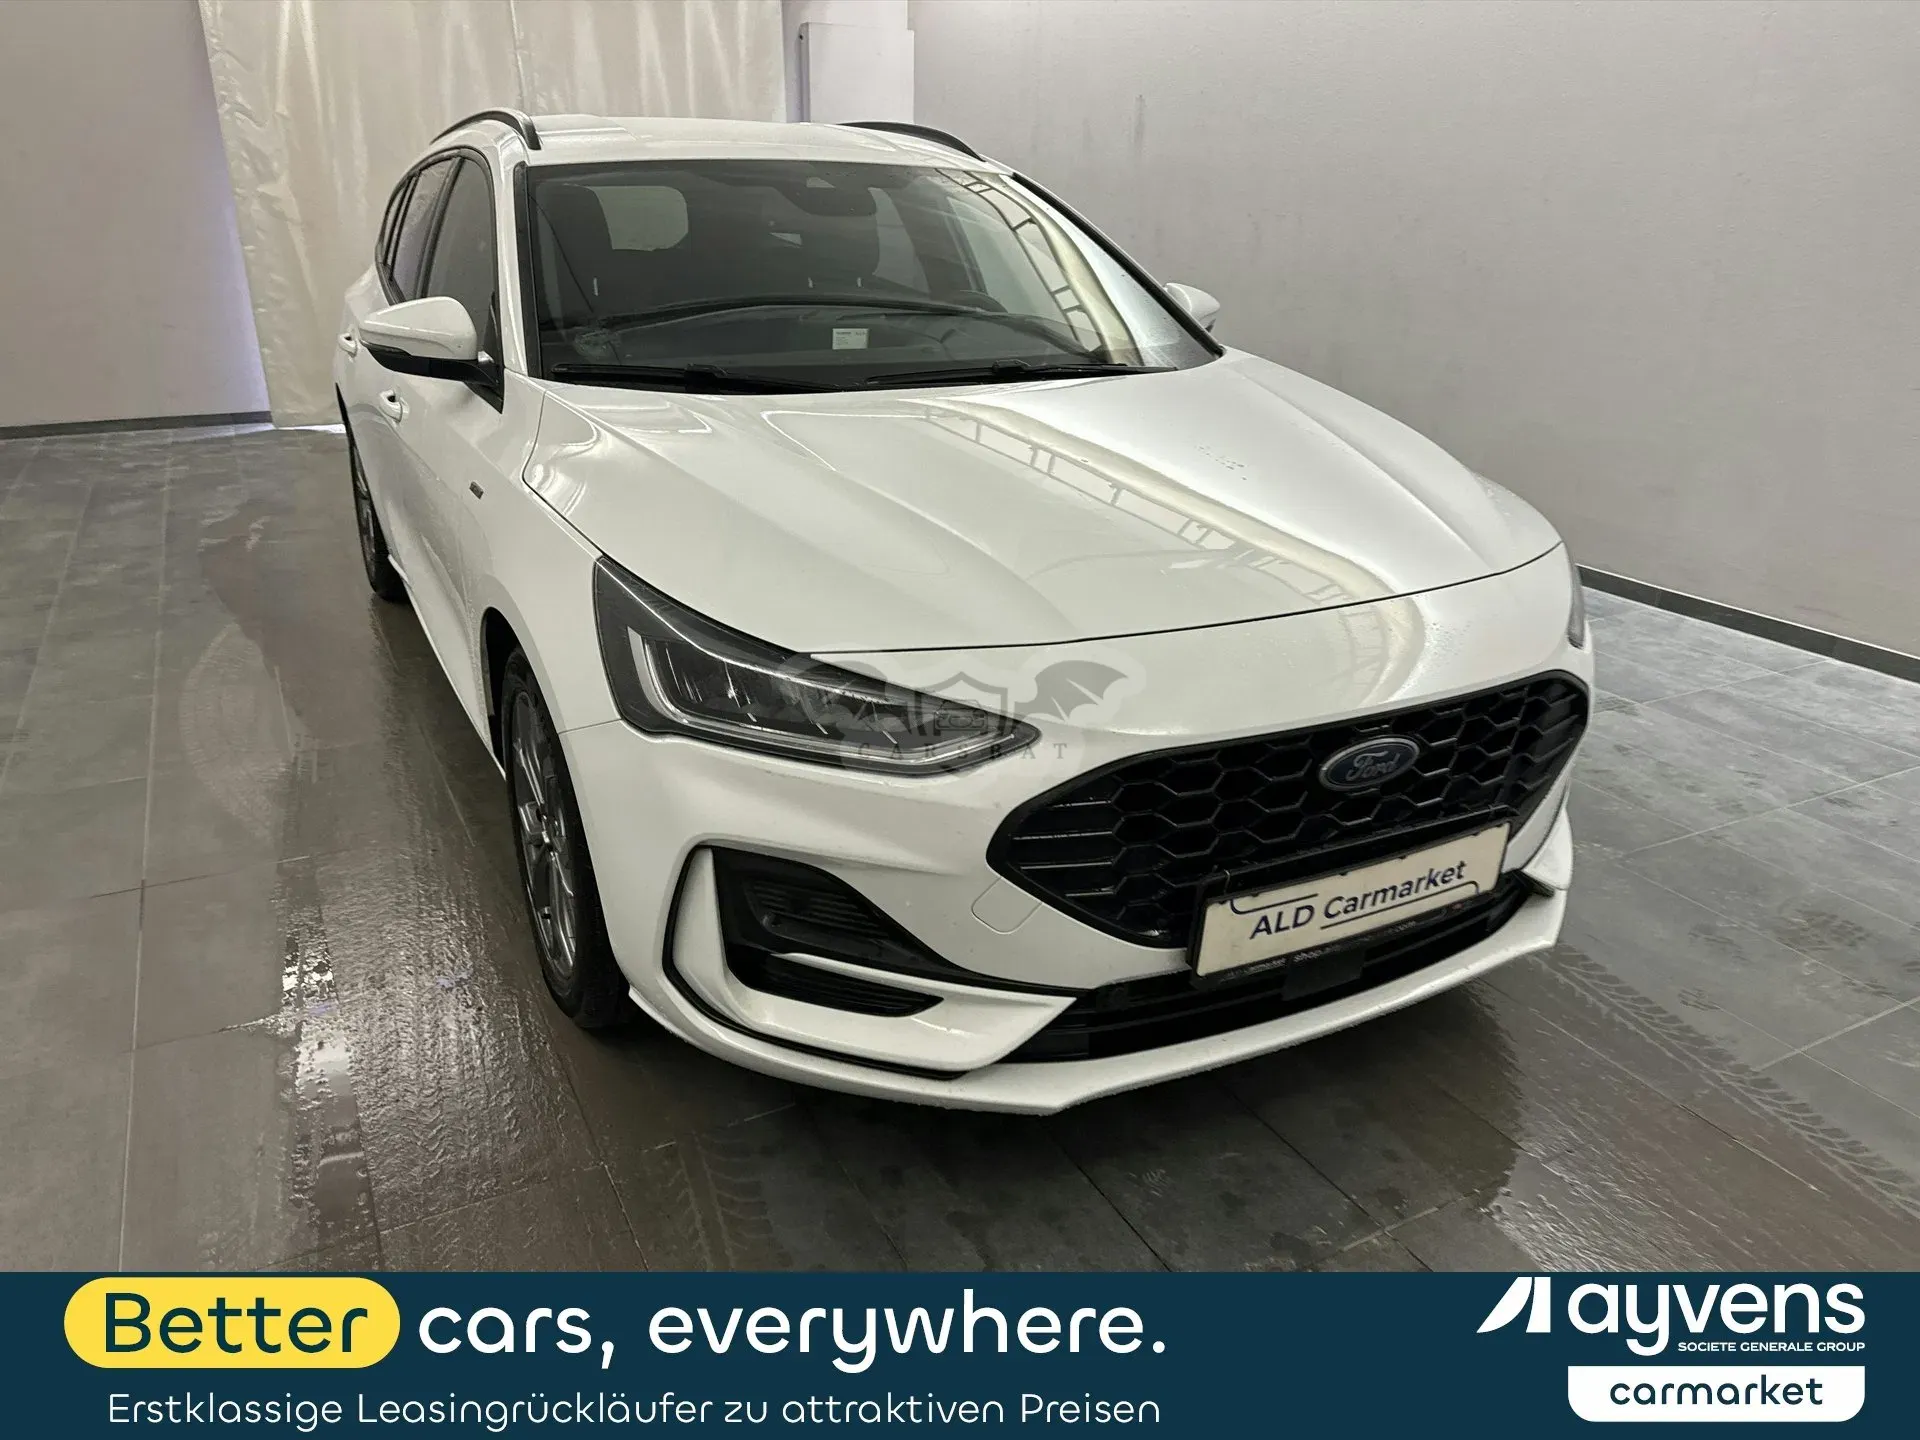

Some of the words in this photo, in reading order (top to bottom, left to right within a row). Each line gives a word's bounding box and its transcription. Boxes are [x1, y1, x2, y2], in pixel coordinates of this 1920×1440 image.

[1347, 751, 1400, 782] Ford
[1250, 904, 1316, 939] ALD
[1323, 861, 1467, 920] Carmarket
